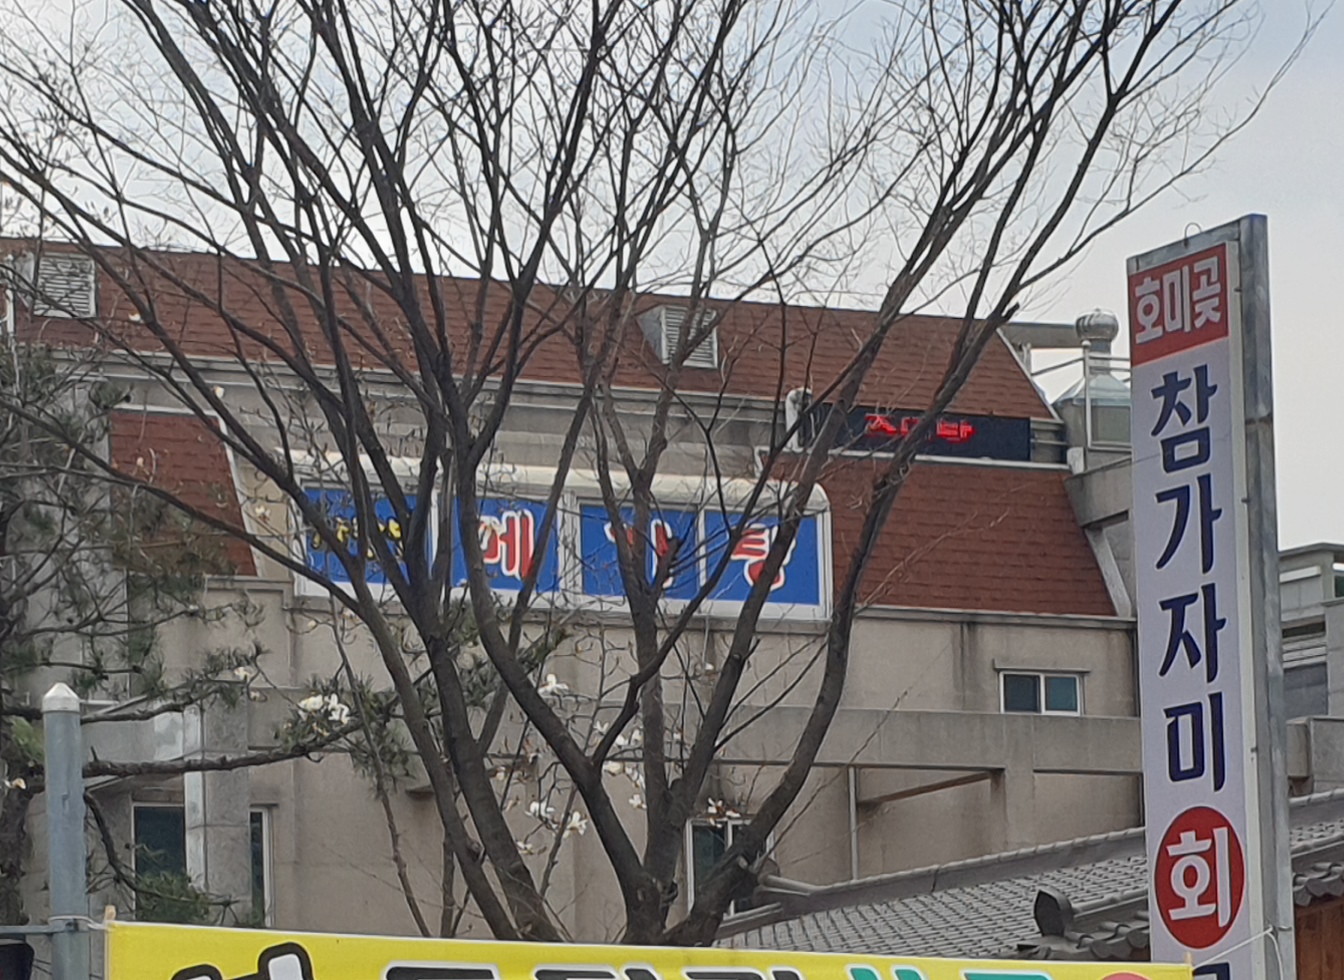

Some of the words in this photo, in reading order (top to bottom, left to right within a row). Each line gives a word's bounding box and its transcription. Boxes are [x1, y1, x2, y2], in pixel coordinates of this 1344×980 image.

[1134, 254, 1222, 346] 호미곶
[1149, 362, 1227, 792] 참가자미
[1165, 826, 1233, 929] 회
